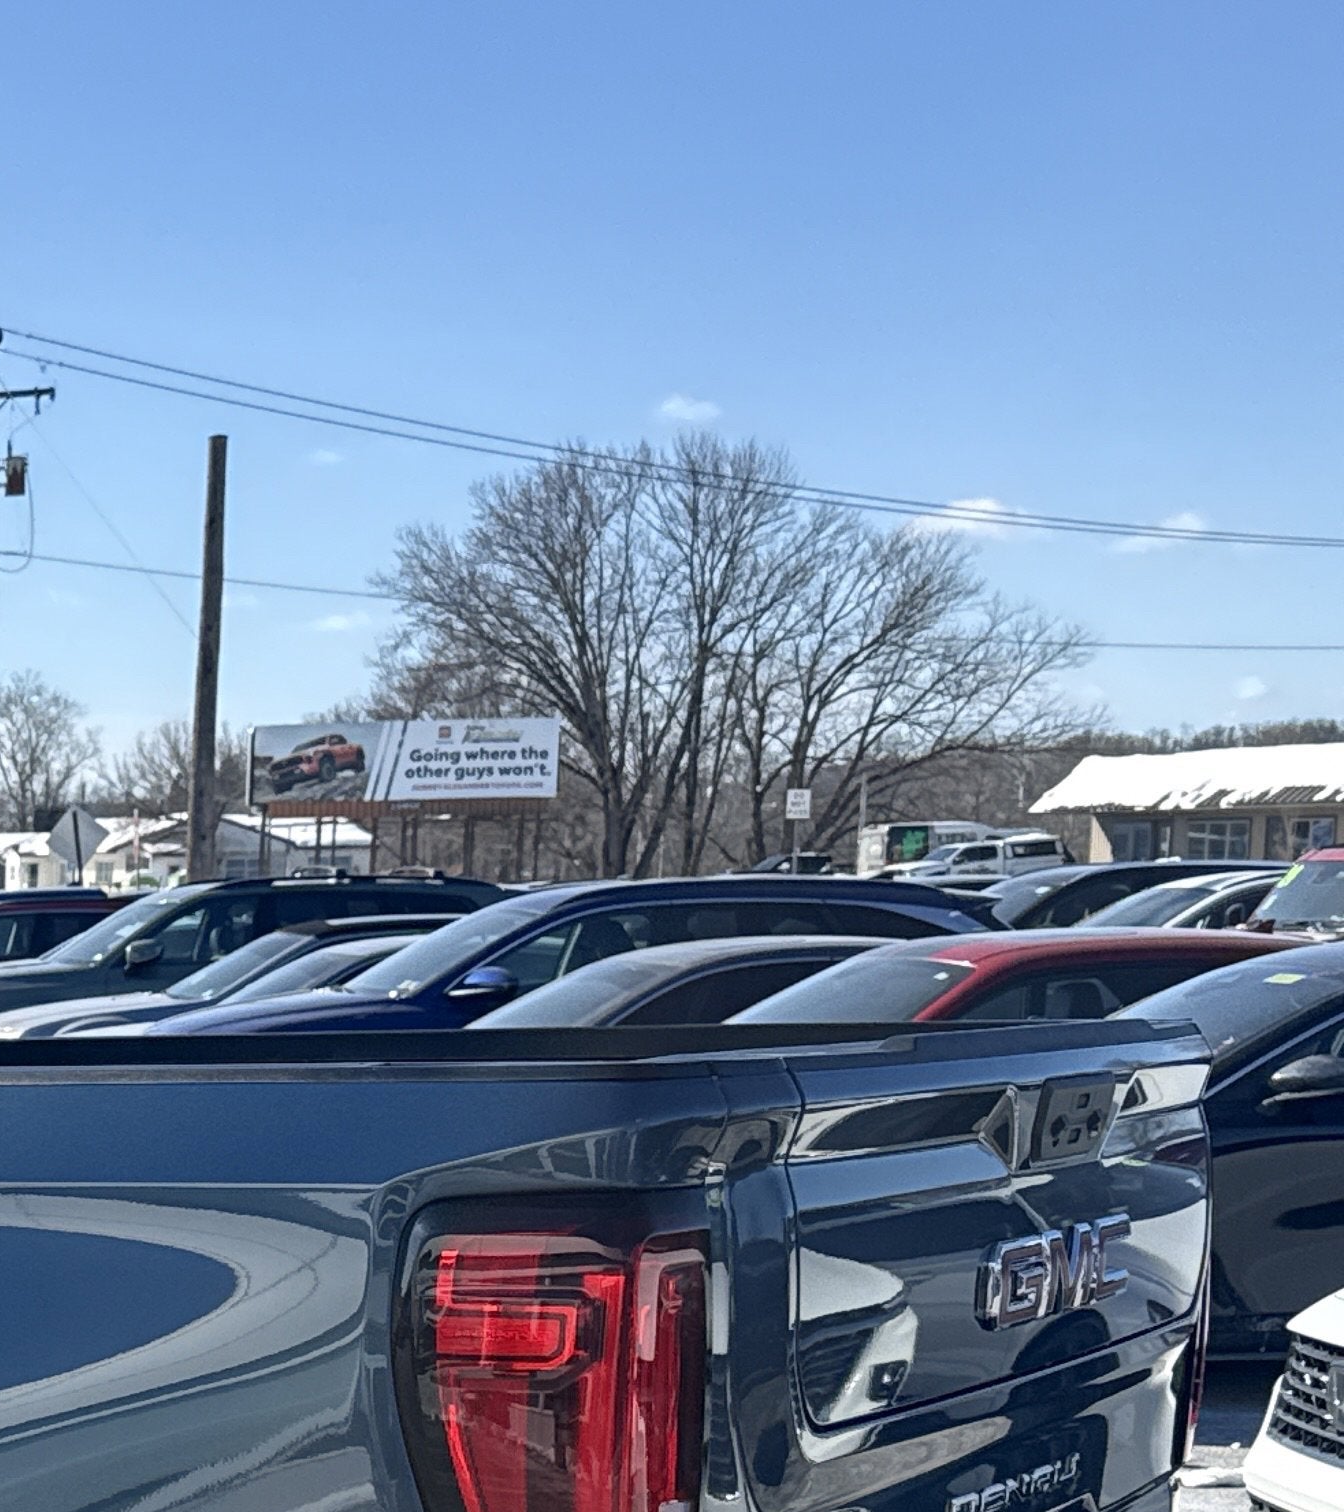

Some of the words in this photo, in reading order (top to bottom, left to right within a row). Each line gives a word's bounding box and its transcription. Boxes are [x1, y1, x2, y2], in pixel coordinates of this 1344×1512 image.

[409, 748, 461, 764] Going
[464, 746, 517, 761] where
[520, 745, 549, 760] the
[404, 765, 451, 779] other
[454, 765, 494, 780] guys
[974, 1212, 1131, 1332] GMC
